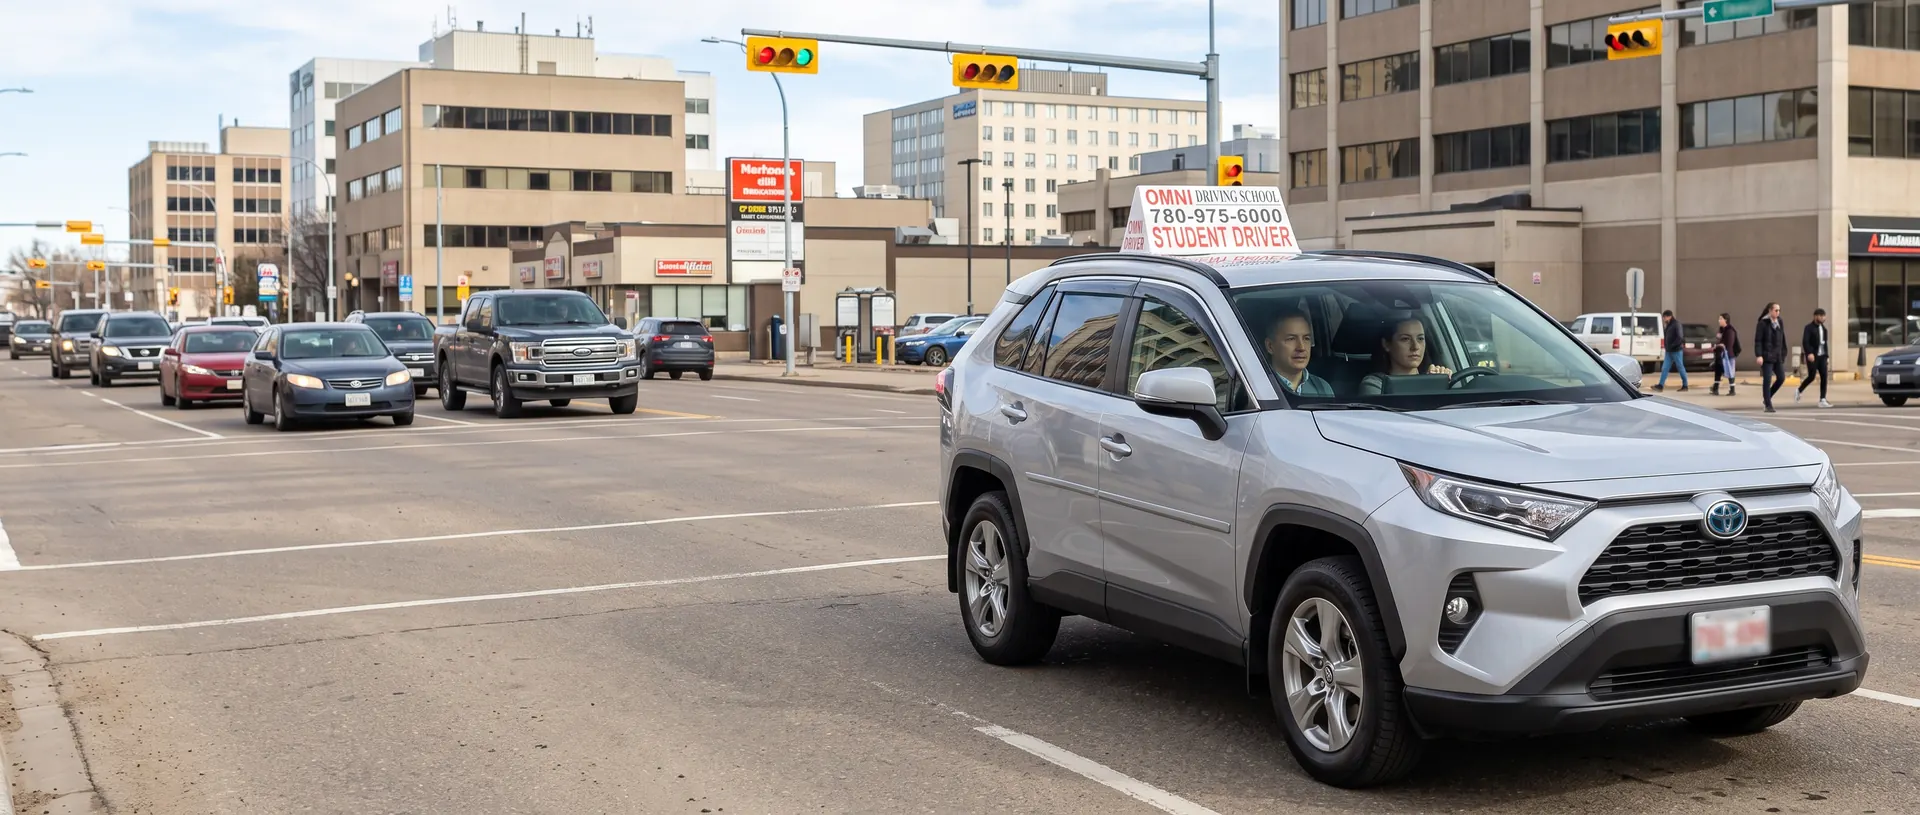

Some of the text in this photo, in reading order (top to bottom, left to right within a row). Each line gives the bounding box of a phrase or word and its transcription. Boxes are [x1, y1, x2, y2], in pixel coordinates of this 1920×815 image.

[1145, 189, 1280, 206] OMNI DRIVING SCHOOL
[1150, 208, 1282, 223] 780-975-6000
[1128, 219, 1143, 235] OMNI
[1123, 236, 1145, 251] DRIVER
[1152, 225, 1293, 248] STUDENT DRIVER
